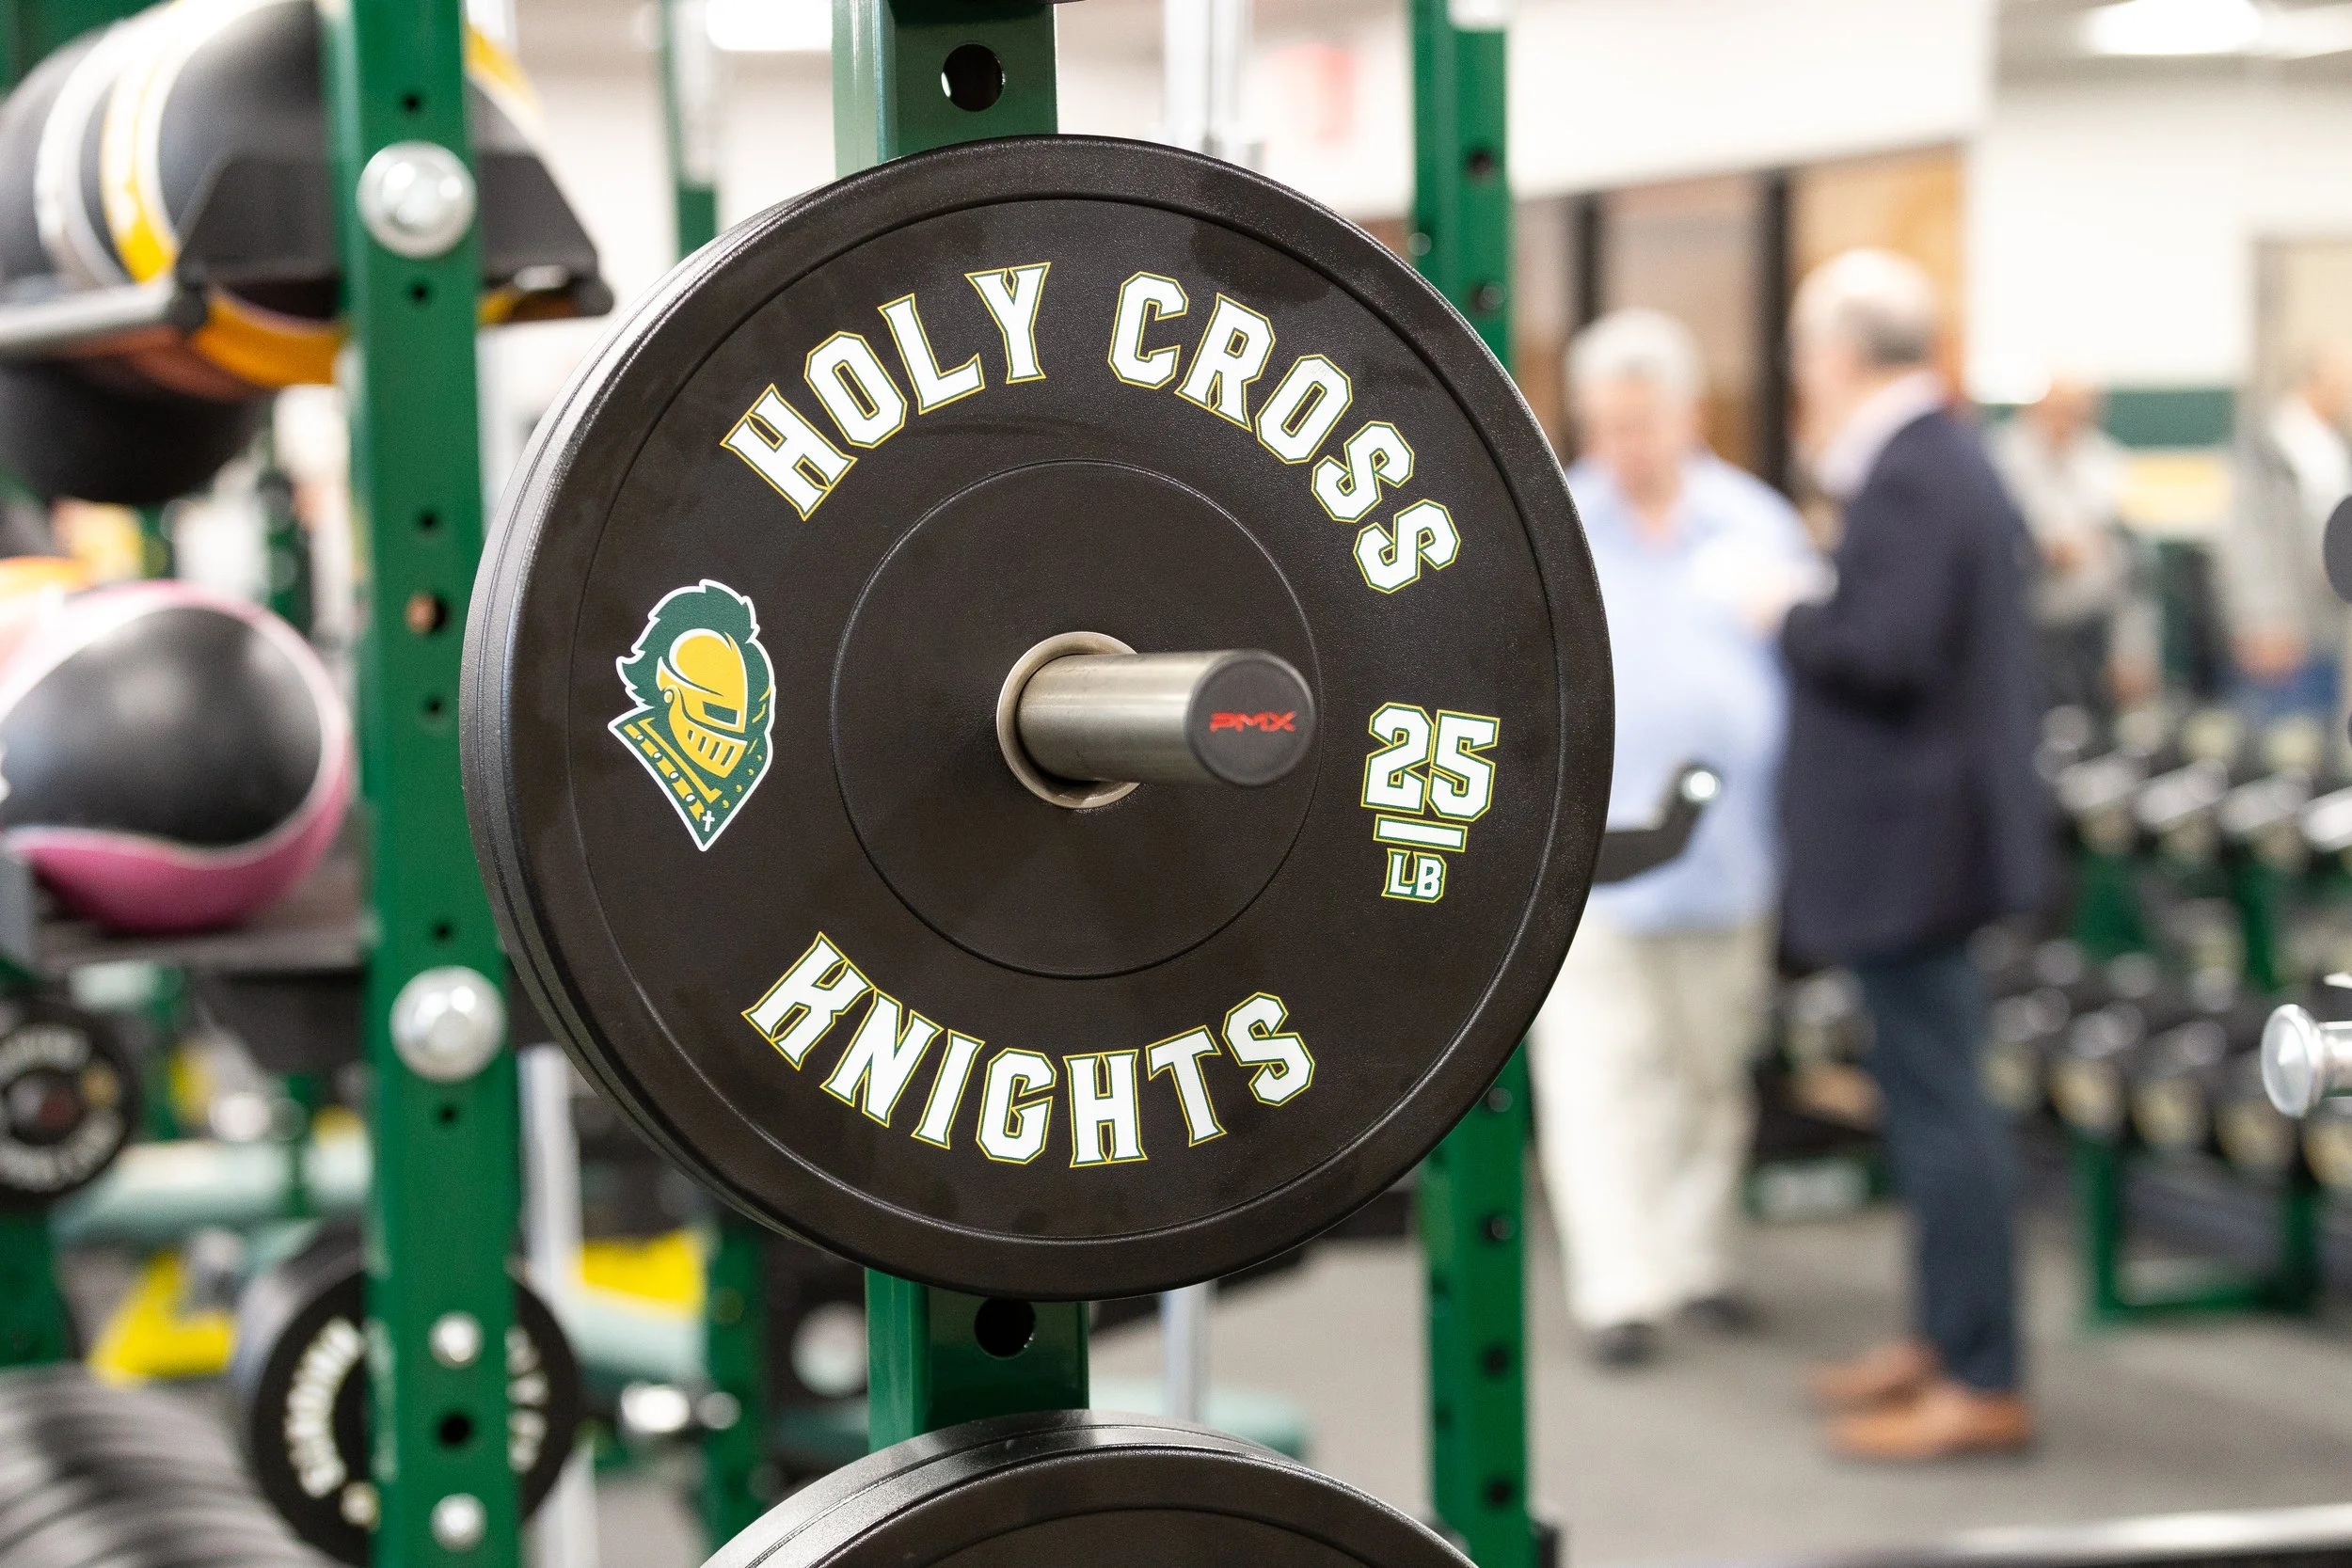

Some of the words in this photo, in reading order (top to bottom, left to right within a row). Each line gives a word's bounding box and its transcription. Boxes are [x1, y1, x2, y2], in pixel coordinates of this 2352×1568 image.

[721, 261, 1052, 521] HOLY
[1107, 271, 1460, 594] CROSS
[1209, 710, 1295, 733] PMX
[1360, 702, 1501, 821] 25
[1381, 847, 1447, 903] LB
[741, 931, 1314, 1167] KNIGHTS
